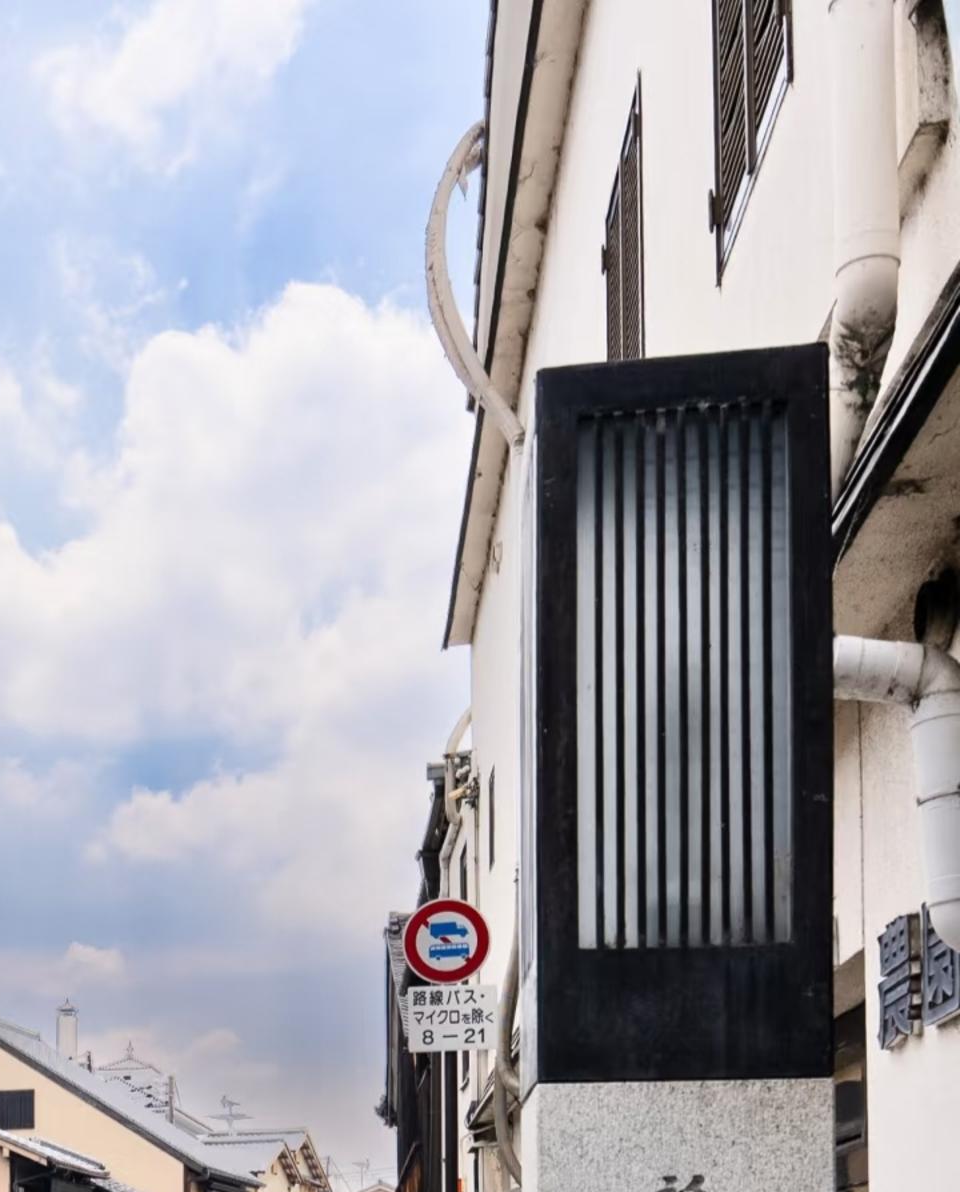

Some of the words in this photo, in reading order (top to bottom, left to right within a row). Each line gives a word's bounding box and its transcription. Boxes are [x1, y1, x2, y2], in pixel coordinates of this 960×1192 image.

[413, 1008, 495, 1026] マイクロを除く
